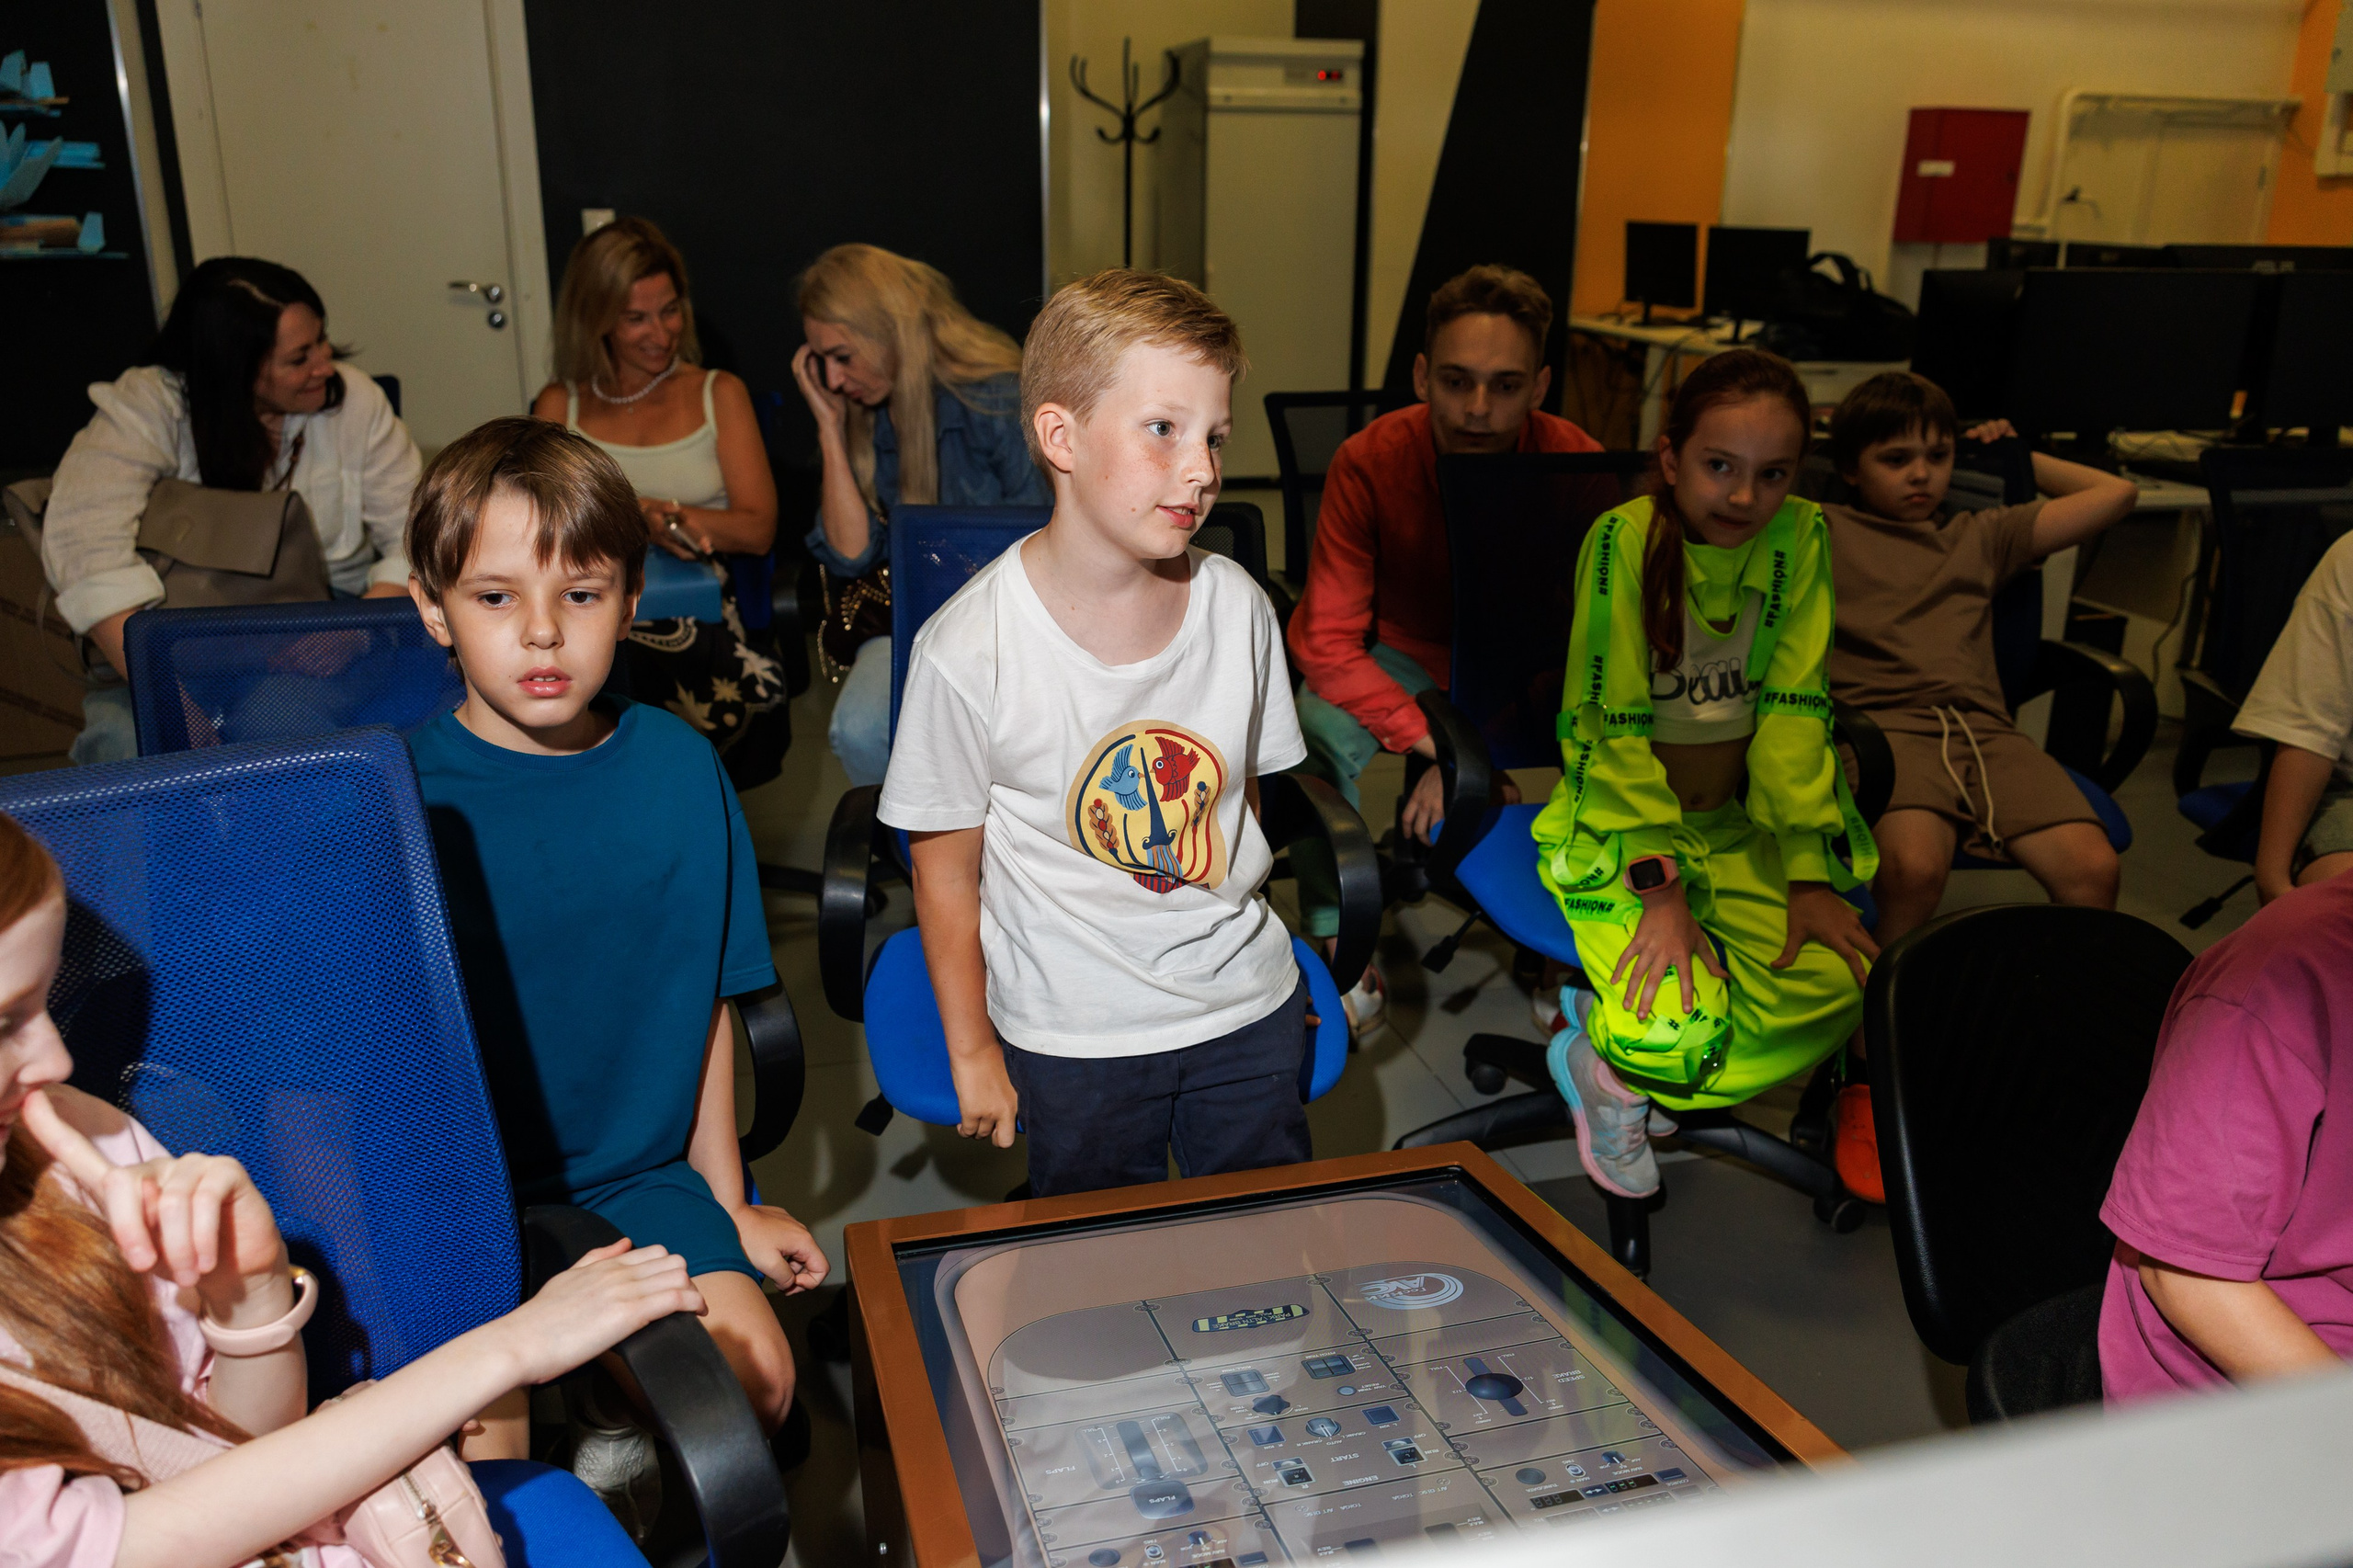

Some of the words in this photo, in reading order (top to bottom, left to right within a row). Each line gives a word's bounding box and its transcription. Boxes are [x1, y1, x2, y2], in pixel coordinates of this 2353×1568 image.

[1552, 1369, 1581, 1379] BRAKE
[1558, 1375, 1586, 1383] SPEED
[1331, 1453, 1359, 1462] START
[1046, 1466, 1075, 1475] FLAPS
[1343, 1475, 1379, 1486] ENGINE
[1149, 1494, 1176, 1504] FLAPS
